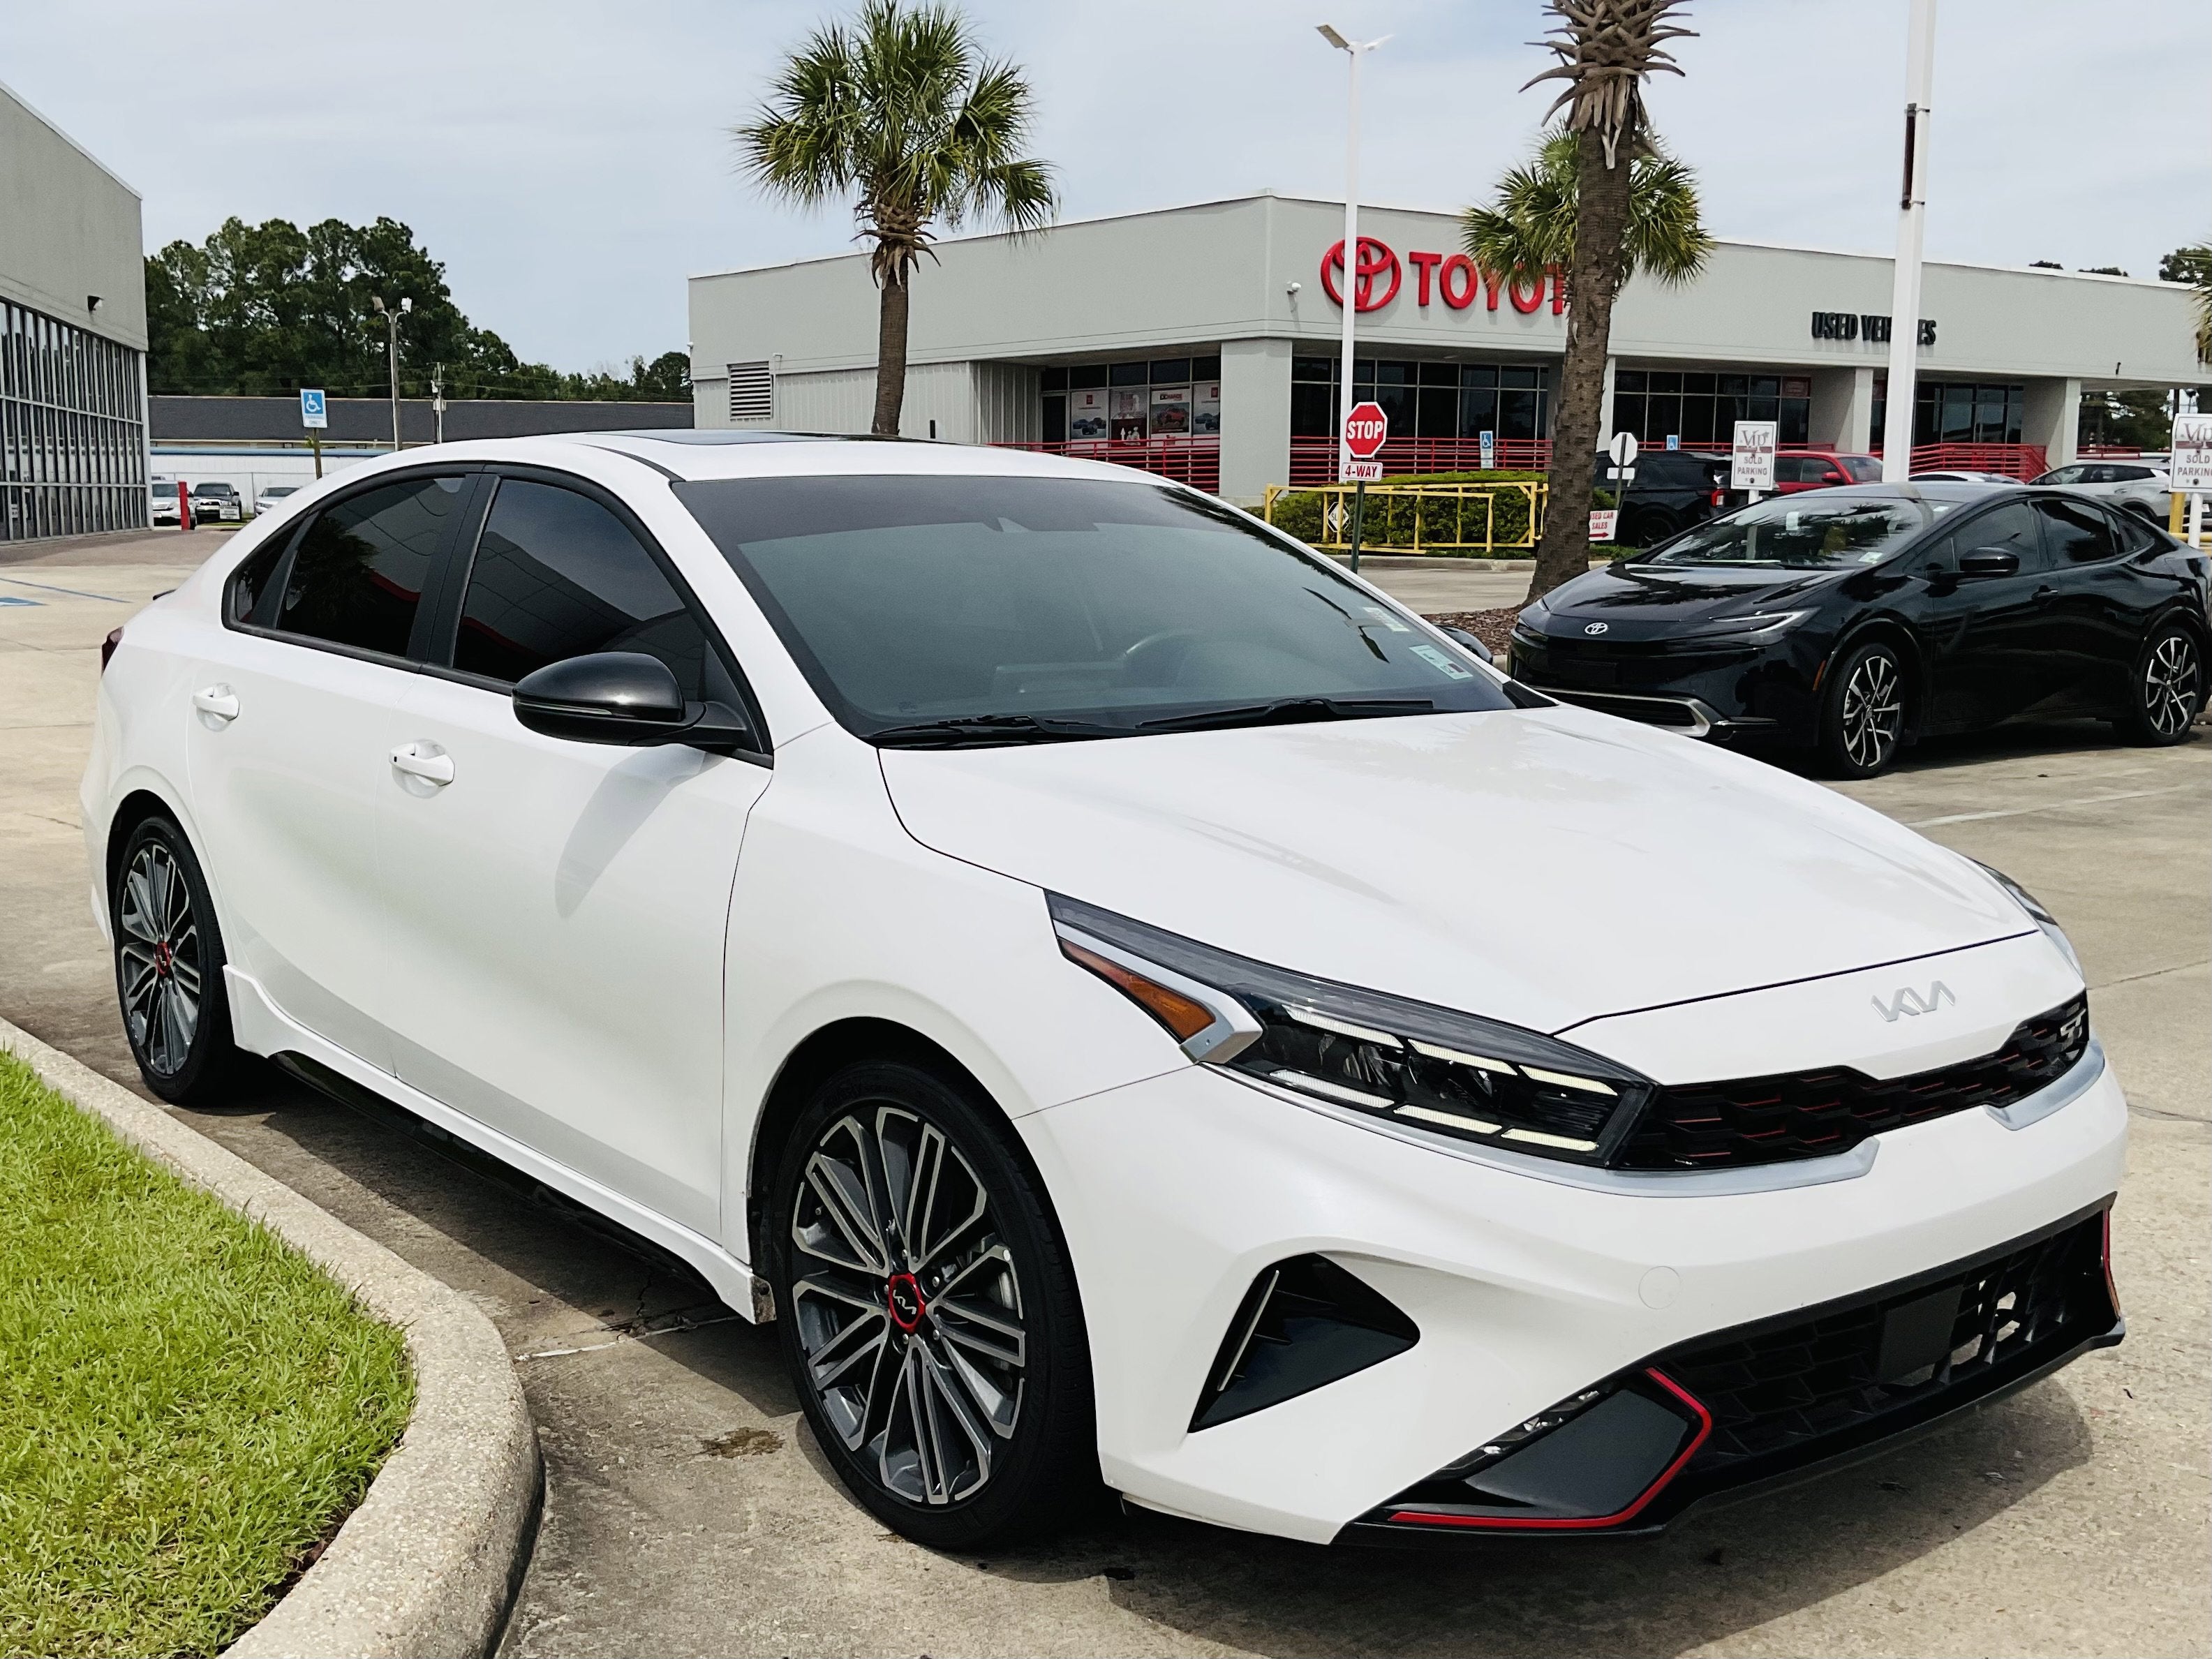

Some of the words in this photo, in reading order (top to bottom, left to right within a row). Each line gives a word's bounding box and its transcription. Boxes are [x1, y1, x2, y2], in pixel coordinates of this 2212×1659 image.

[1409, 251, 1564, 315] TOYOT
[1811, 312, 1858, 339] USED
[1861, 315, 1936, 345] VEHES
[1347, 420, 1383, 440] STOP
[2186, 454, 2210, 463] SOLD
[1345, 465, 1377, 477] 4-WAY
[1737, 467, 1767, 475] PARKING
[2178, 467, 2212, 475] PARKIN
[1871, 981, 1955, 1022] KIA
